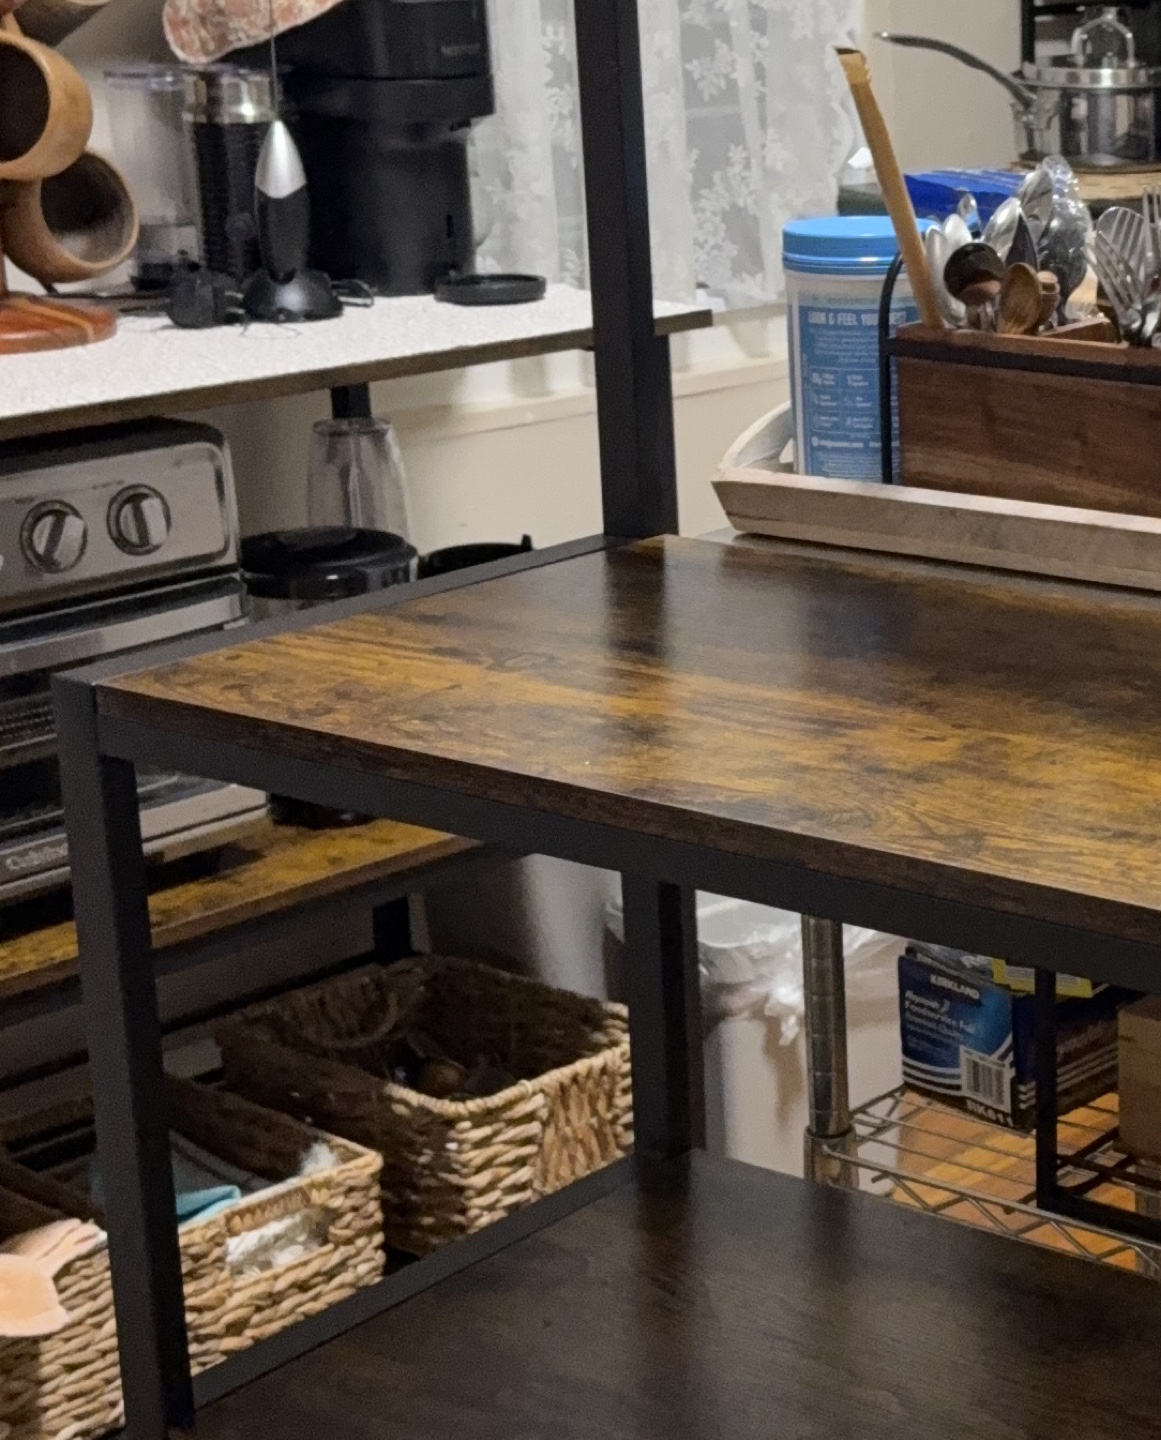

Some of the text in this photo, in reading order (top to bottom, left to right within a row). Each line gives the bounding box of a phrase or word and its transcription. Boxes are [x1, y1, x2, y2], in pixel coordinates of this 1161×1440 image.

[837, 312, 858, 326] FEEL
[860, 312, 881, 326] YOU
[929, 972, 981, 1001] KIRKLAND
